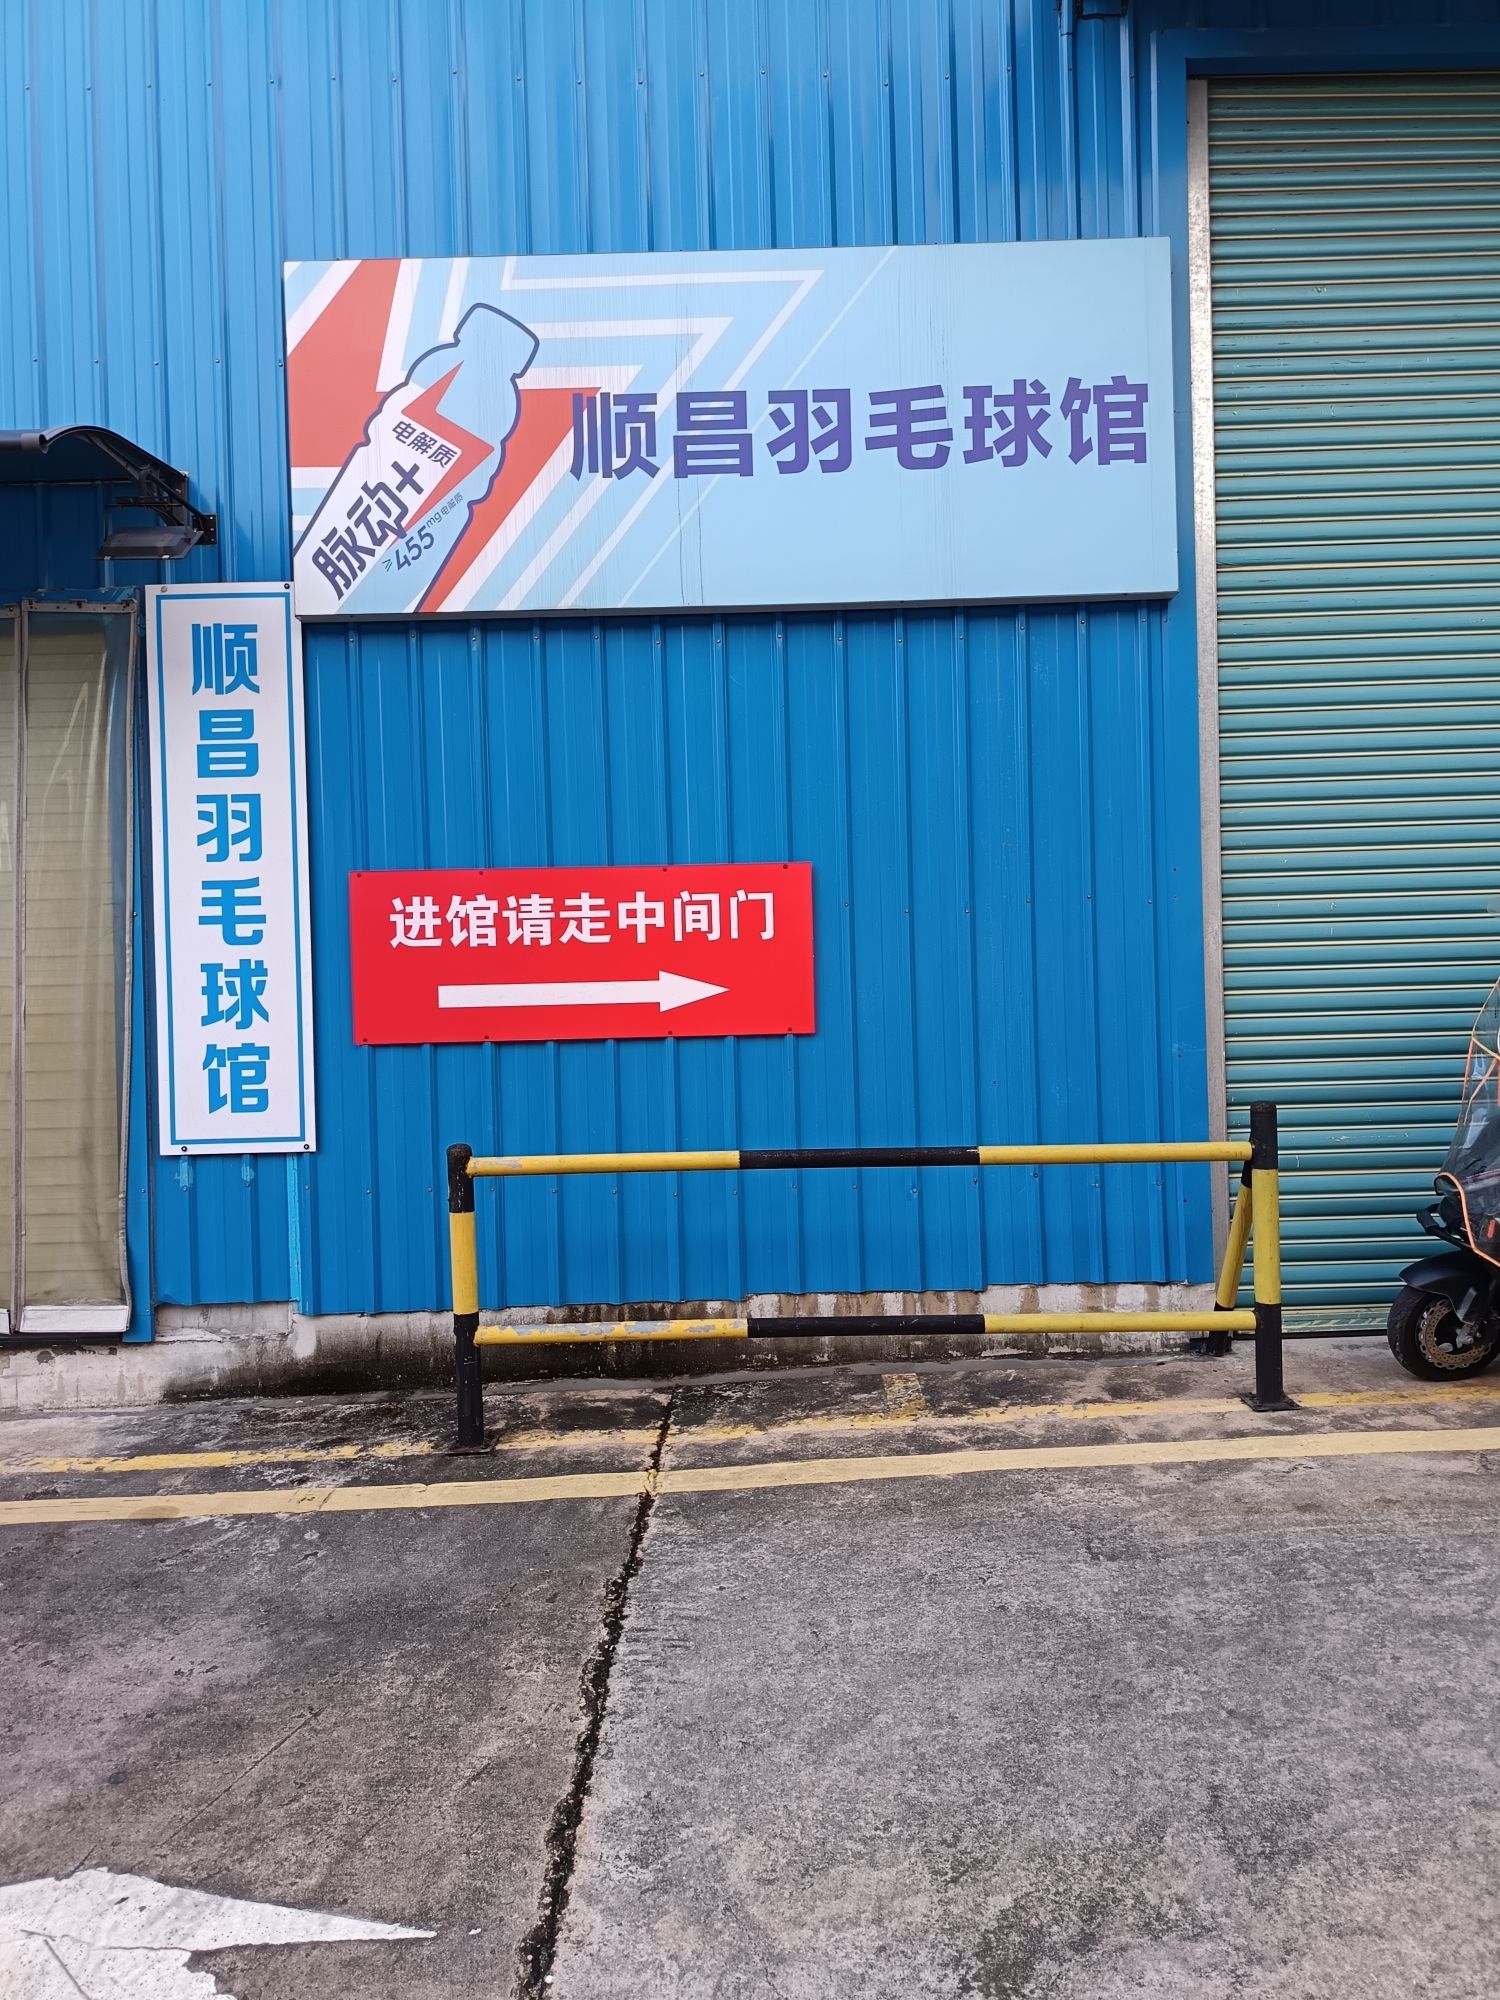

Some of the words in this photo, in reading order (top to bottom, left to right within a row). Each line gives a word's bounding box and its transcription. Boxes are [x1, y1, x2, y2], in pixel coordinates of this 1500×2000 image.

[392, 421, 458, 468] 电解质
[569, 375, 1149, 482] 顺昌羽毛球馆
[191, 623, 271, 1115] 顺昌羽毛球馆
[389, 889, 776, 949] 进馆请走中间门
